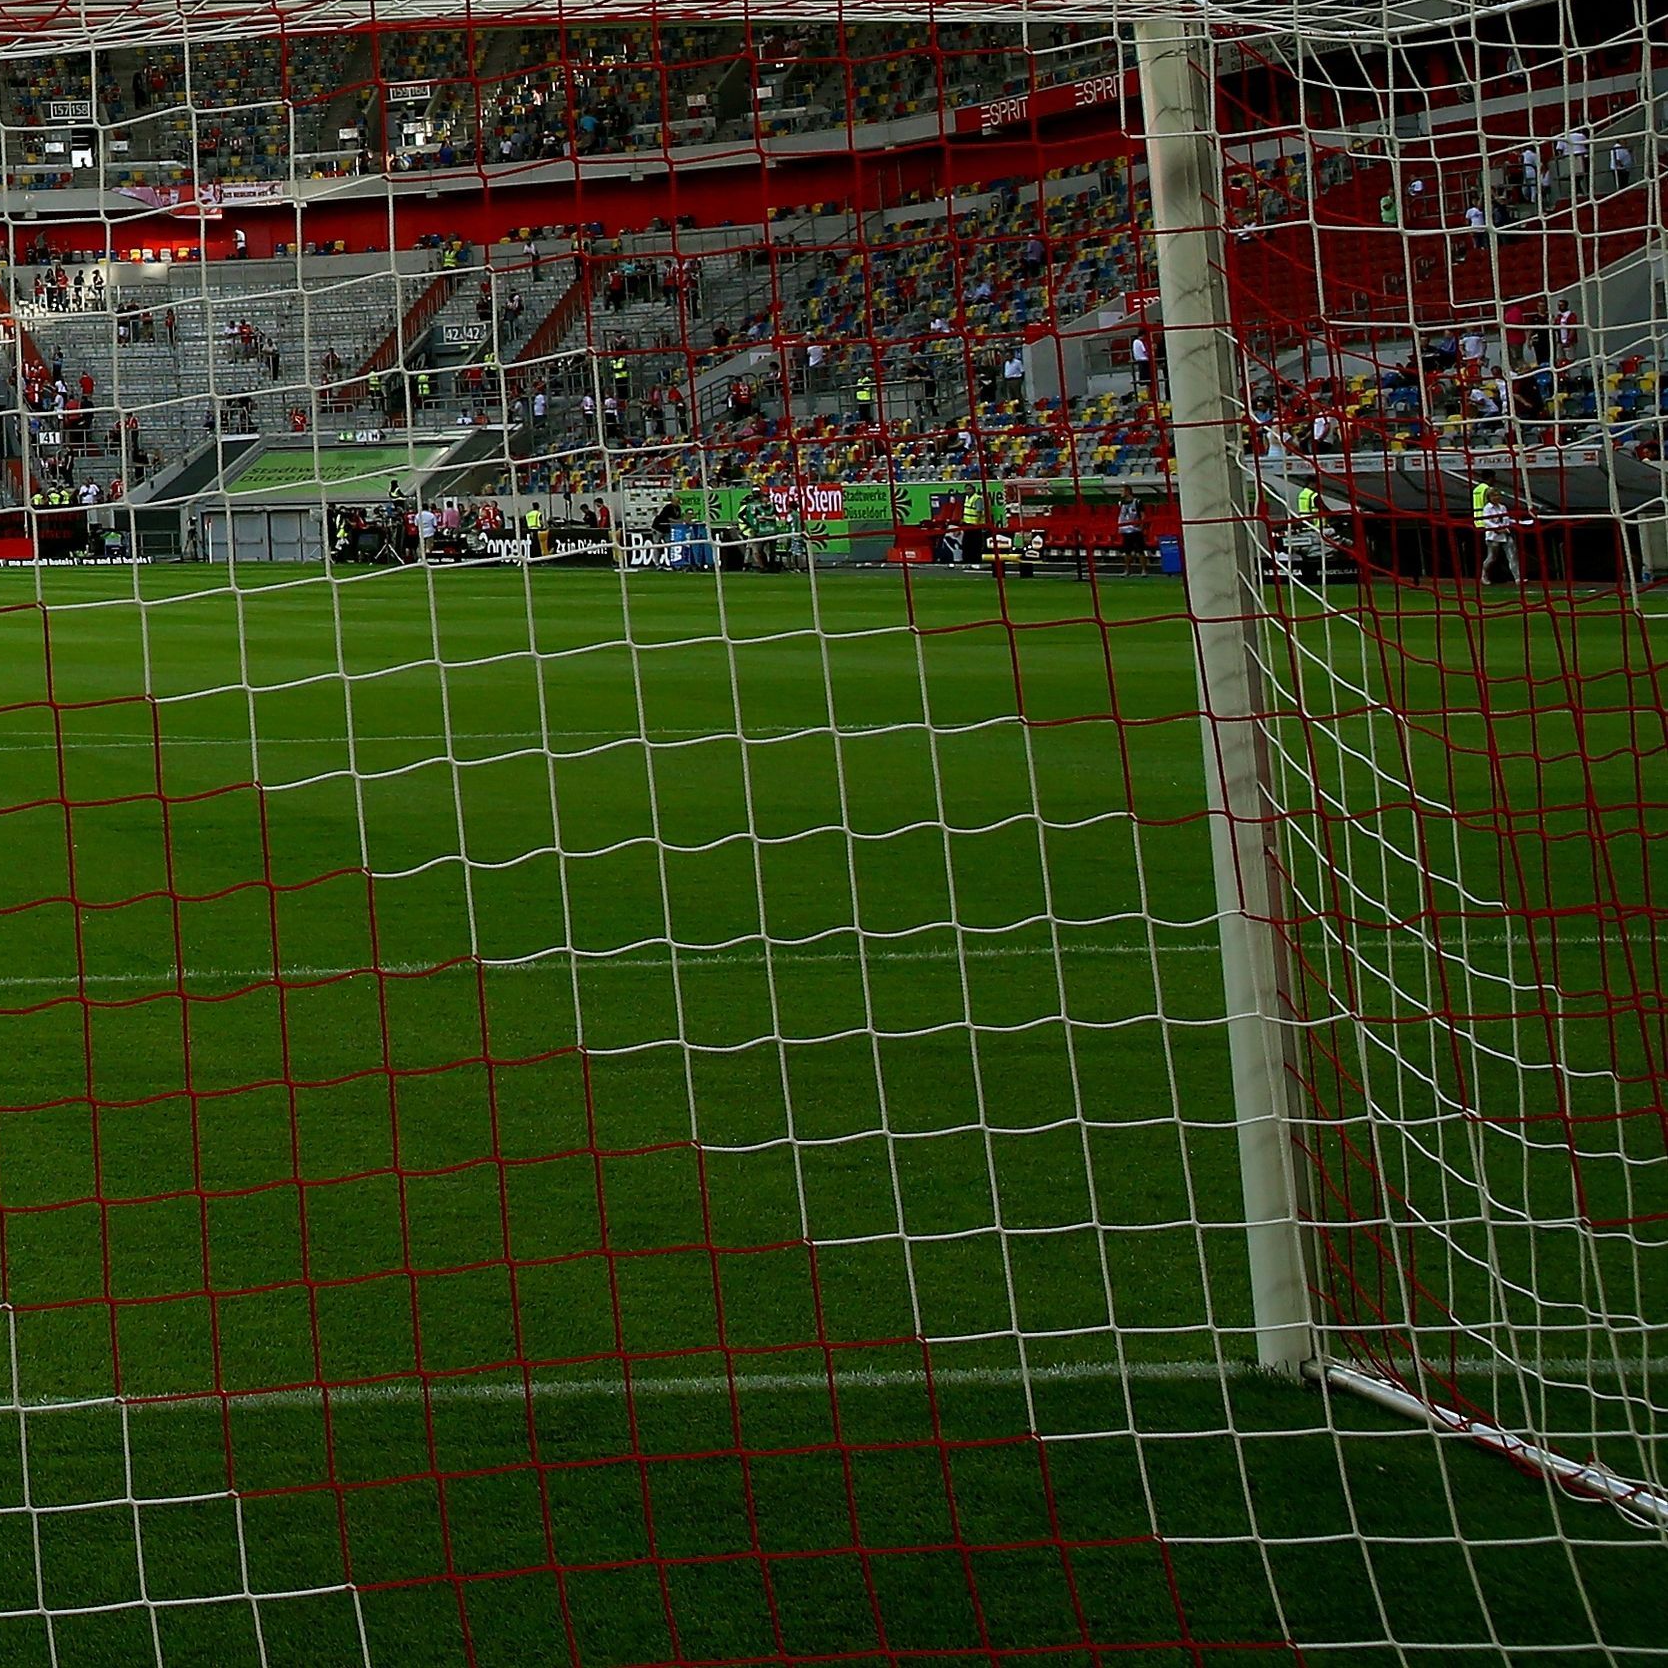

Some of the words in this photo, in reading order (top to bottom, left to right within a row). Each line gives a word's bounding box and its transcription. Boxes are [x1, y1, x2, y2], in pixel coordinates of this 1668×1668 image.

[54, 105, 69, 115] 157
[981, 96, 1028, 127] ESPRIT
[806, 485, 842, 512] Stern
[843, 489, 887, 502] Stadtwerke
[843, 506, 888, 519] Düsseldorf
[122, 556, 147, 564] hoels
